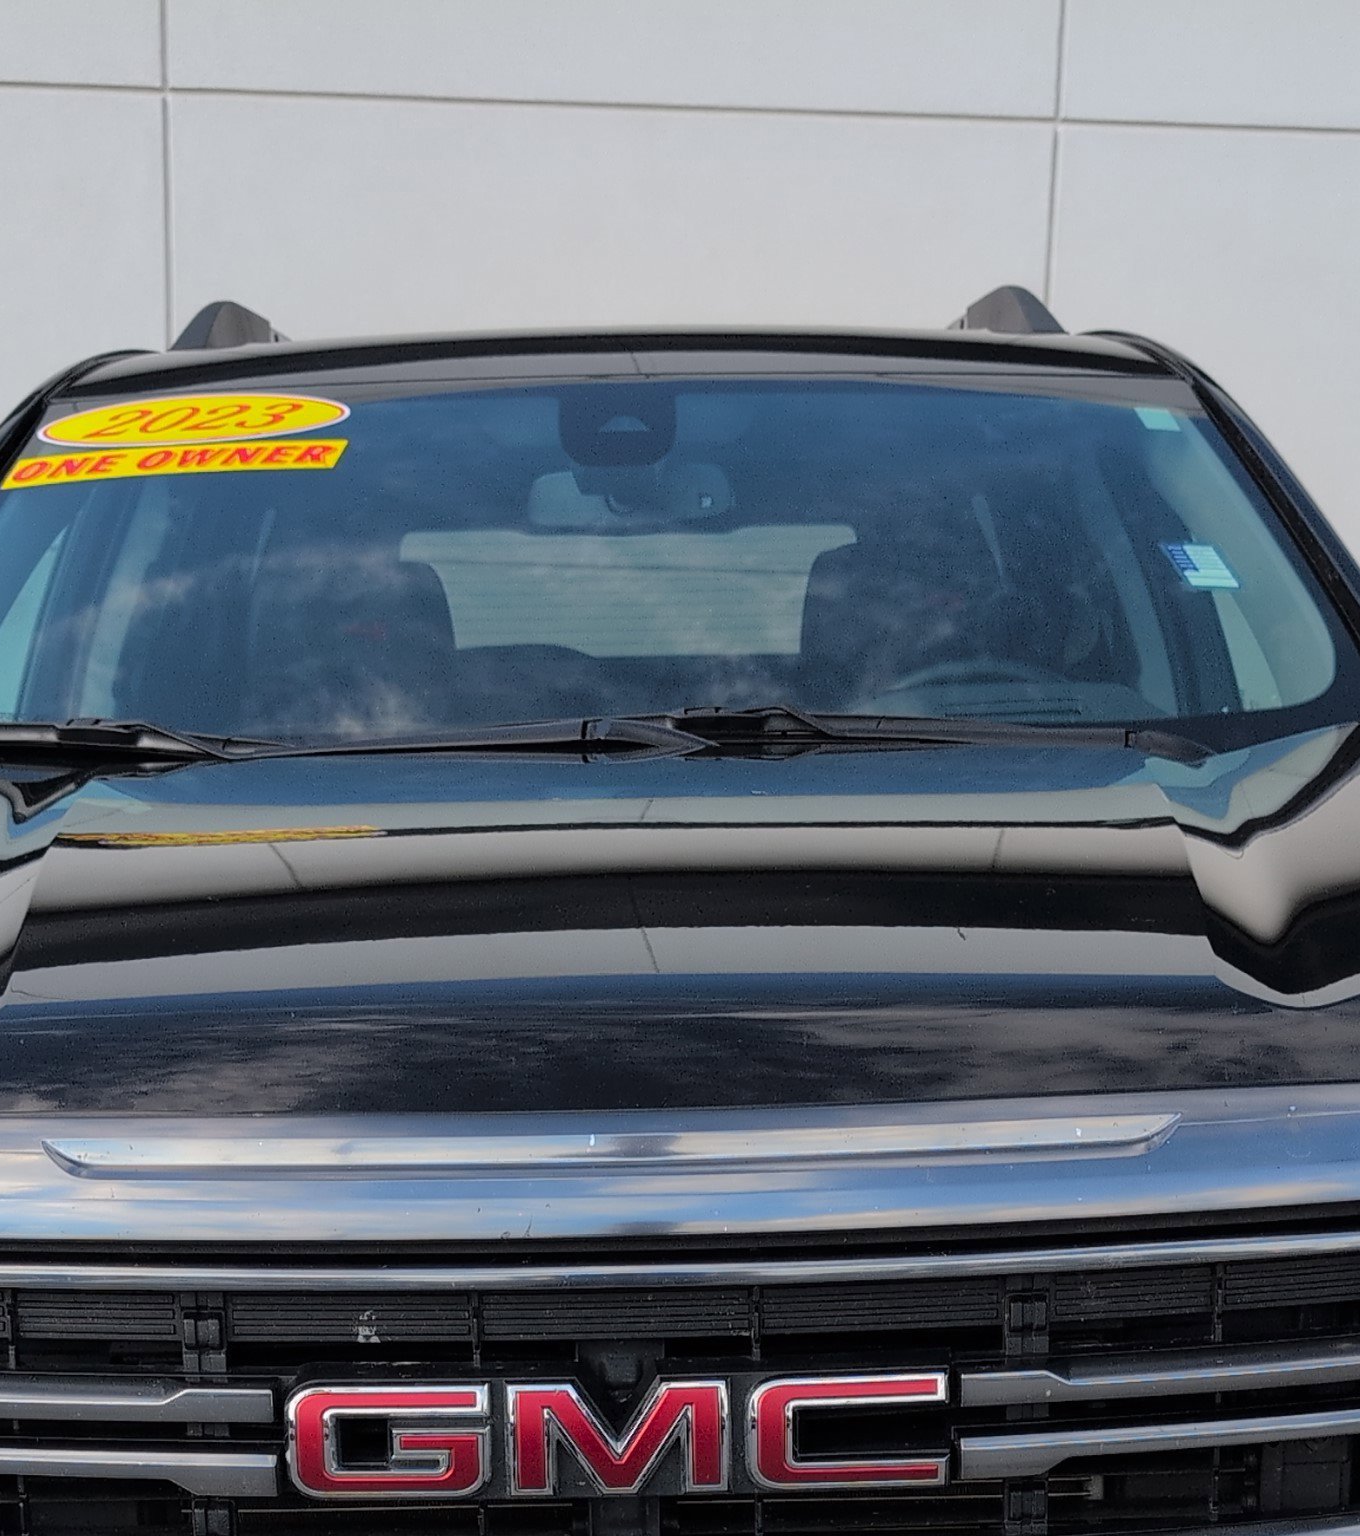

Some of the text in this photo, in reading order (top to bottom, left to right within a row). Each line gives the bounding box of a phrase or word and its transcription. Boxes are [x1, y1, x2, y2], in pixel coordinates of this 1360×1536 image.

[80, 402, 303, 439] 2023
[10, 444, 337, 482] ONE OWNER
[287, 1371, 950, 1499] GMC
